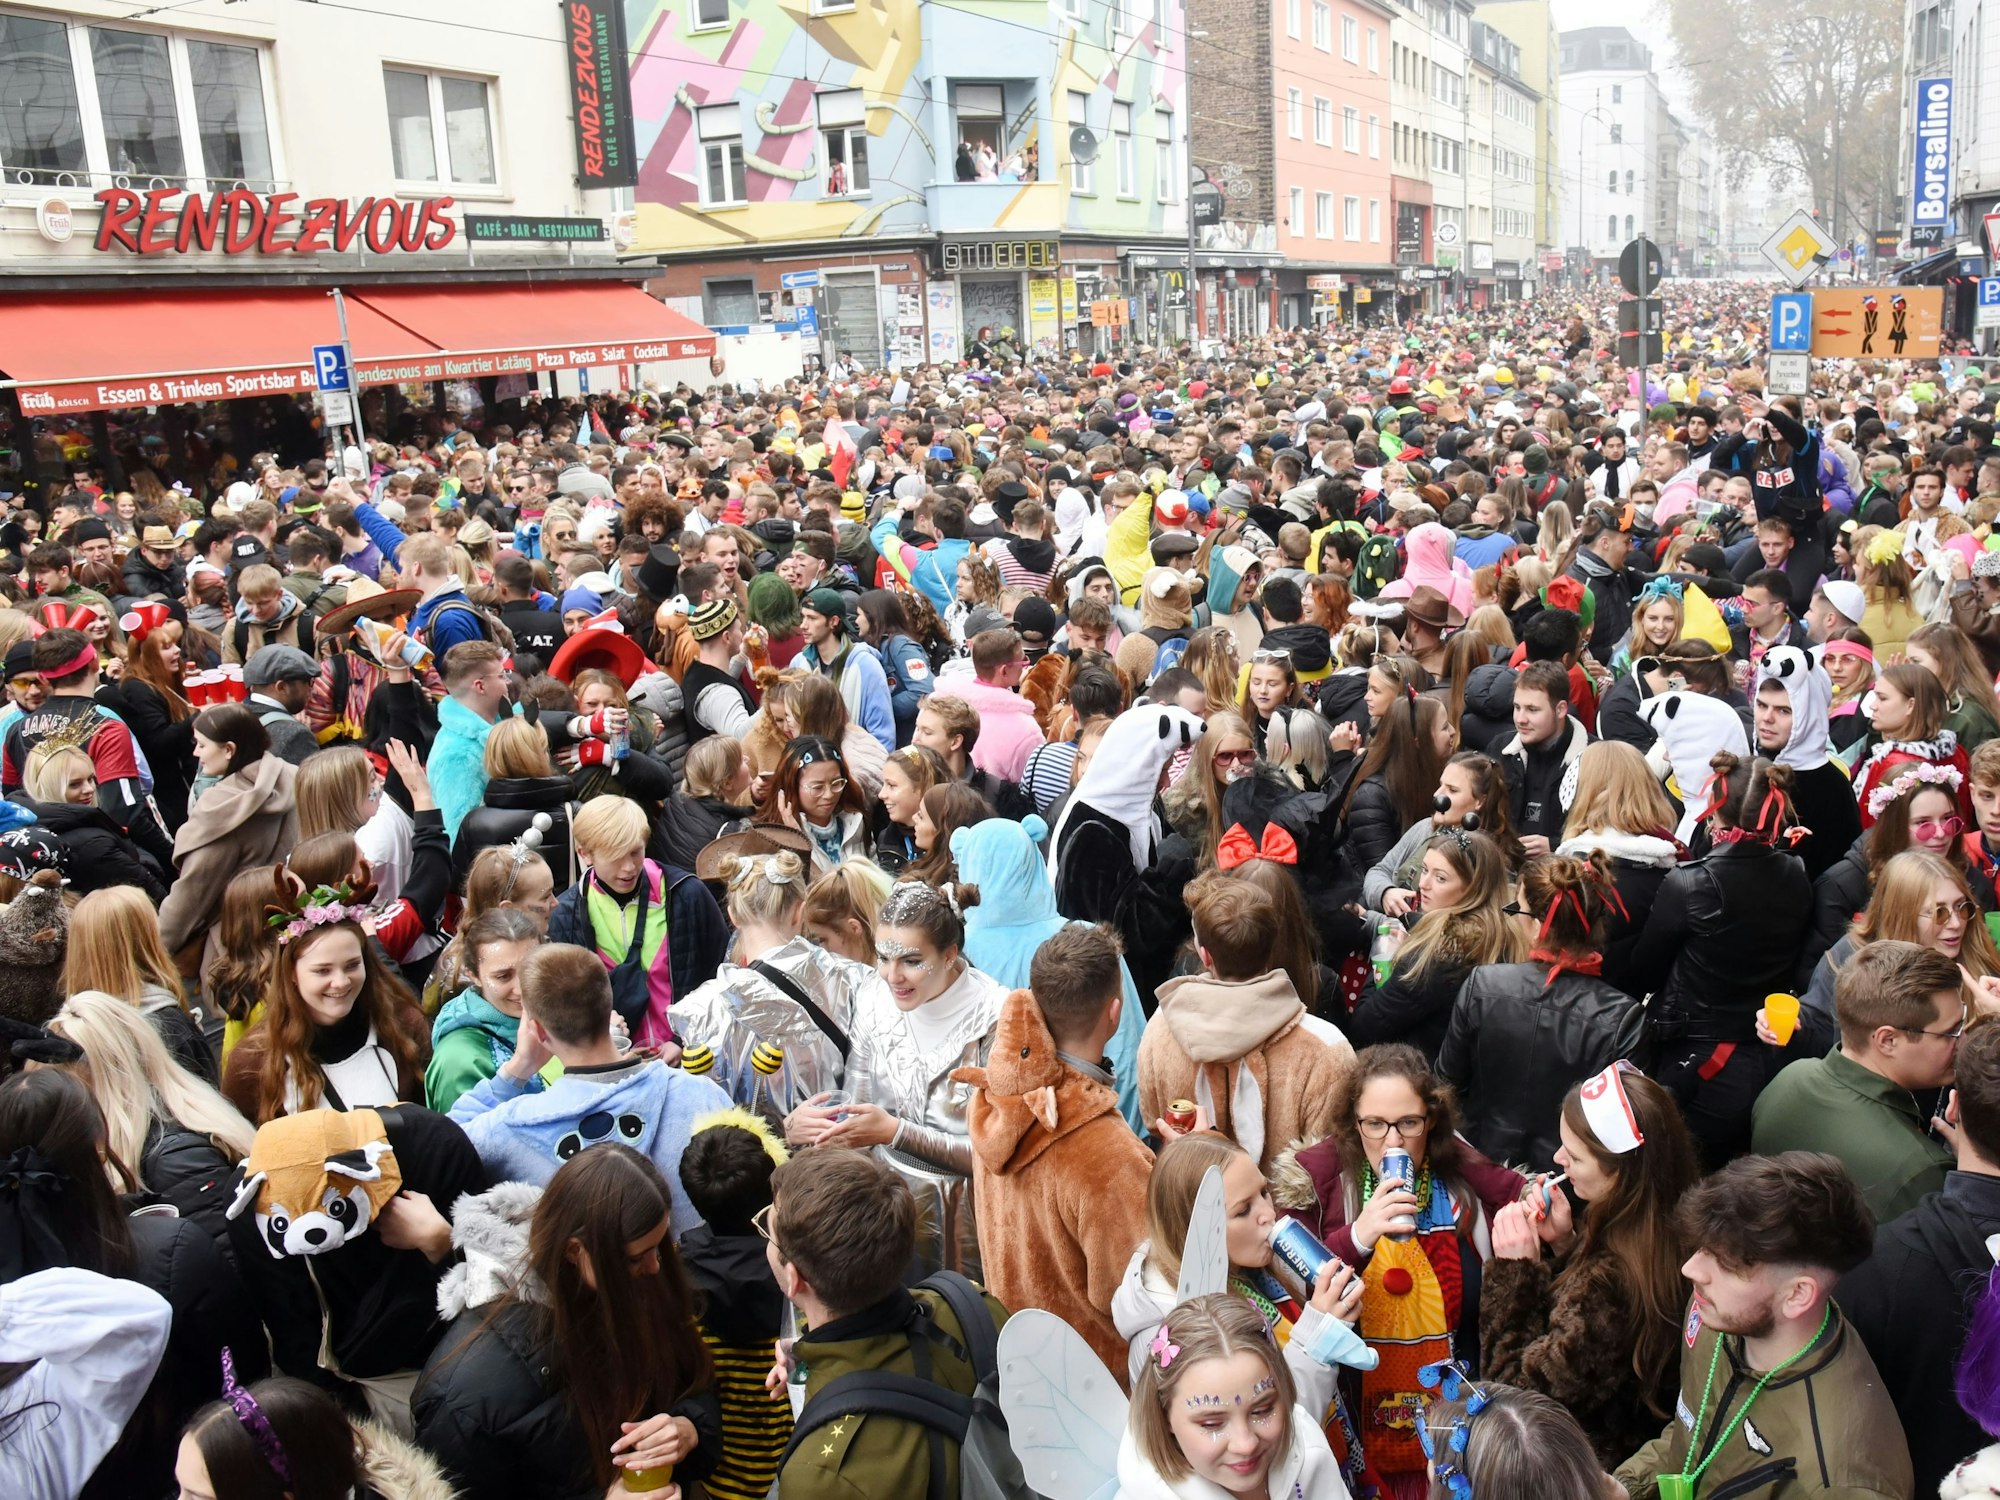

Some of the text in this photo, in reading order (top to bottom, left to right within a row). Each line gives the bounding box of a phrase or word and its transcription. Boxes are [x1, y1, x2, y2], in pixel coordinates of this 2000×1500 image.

[571, 2, 604, 178] RENDEZVOUS
[596, 13, 618, 167] CAFÉ BAR RESTAURANT
[1917, 83, 1949, 219] Borsalino
[94, 186, 456, 255] RENDEZVOUS
[476, 221, 598, 238] CAFÉ BAR RESTAURANT
[1913, 228, 1938, 241] sky
[945, 243, 1058, 268] STIEFEL
[1437, 269, 1451, 277] sky
[798, 308, 808, 319] P
[1779, 301, 1802, 344] P
[21, 391, 55, 409] früh
[57, 398, 90, 407] KÖLSCH
[97, 385, 149, 405] Essen
[149, 383, 163, 402] &
[164, 376, 223, 400] Trinken
[226, 369, 296, 395] Sportsbar
[356, 364, 421, 384] endezvous
[424, 364, 442, 377] am
[445, 359, 492, 374] Kwartier
[496, 355, 532, 373] Latäng
[537, 352, 565, 368] Pizza
[569, 350, 596, 364] Pasta
[602, 346, 626, 361] Salat
[633, 344, 669, 360] Cocktail
[318, 351, 338, 386] P
[22, 714, 71, 737] JAMES
[1403, 1157, 1414, 1193] ENERGY
[1277, 1240, 1310, 1278] ENERGY
[1402, 1396, 1420, 1404] UNS
